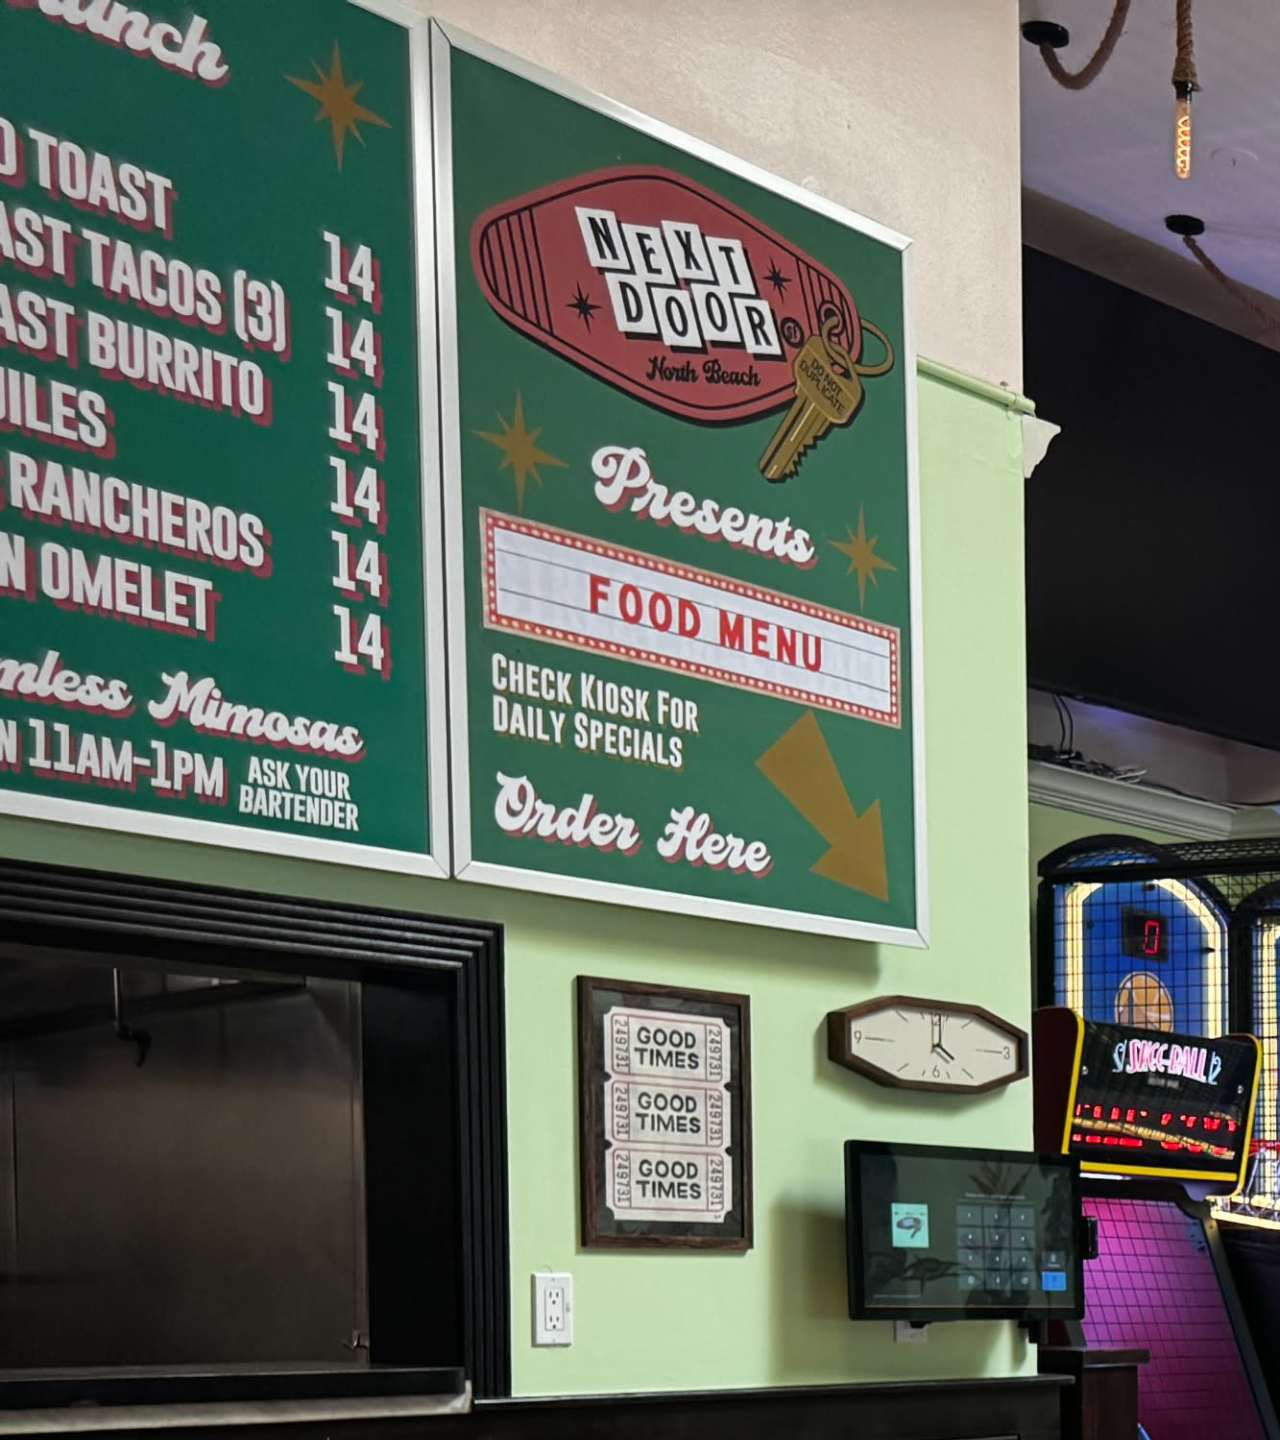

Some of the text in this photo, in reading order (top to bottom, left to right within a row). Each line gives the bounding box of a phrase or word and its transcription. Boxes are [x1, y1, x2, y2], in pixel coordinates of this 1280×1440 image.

[38, 0, 229, 81] unch
[29, 128, 172, 230] TOAST
[323, 230, 375, 304] 14
[587, 215, 740, 286] NEXT
[83, 228, 222, 326] TACOS
[234, 269, 286, 352] (3)
[326, 306, 377, 377] 14
[620, 280, 773, 348] DOOR
[88, 310, 264, 416] BURRITO
[328, 381, 379, 450] 14
[646, 356, 761, 387] North Beach
[800, 360, 847, 415] DUPLICATE
[0, 366, 381, 524] ILES 14
[9, 452, 382, 598] RANCHEROS 14
[591, 446, 815, 564] Presents
[41, 542, 213, 632] OMELET
[334, 604, 384, 670] 14
[589, 574, 823, 673] FOOD MENU
[148, 671, 363, 756] Mimosas
[492, 653, 572, 704] CHECK
[581, 674, 649, 721] KIOSK
[29, 718, 224, 798] 11AM-1PM
[492, 697, 684, 769] DAILY SPECIALS
[239, 784, 359, 832] BARTENDER
[248, 756, 350, 801] ASK YOUR
[494, 771, 772, 873] Order Here
[634, 1047, 699, 1070] TIMES
[637, 1027, 696, 1049] GOOD
[854, 1031, 862, 1044] 9
[1003, 1047, 1011, 1060] 3
[638, 1091, 697, 1113] GOOD
[932, 1065, 941, 1079] 6
[635, 1112, 701, 1134] TIMES
[636, 1180, 701, 1201] TIMES
[638, 1159, 698, 1179] GOOD
